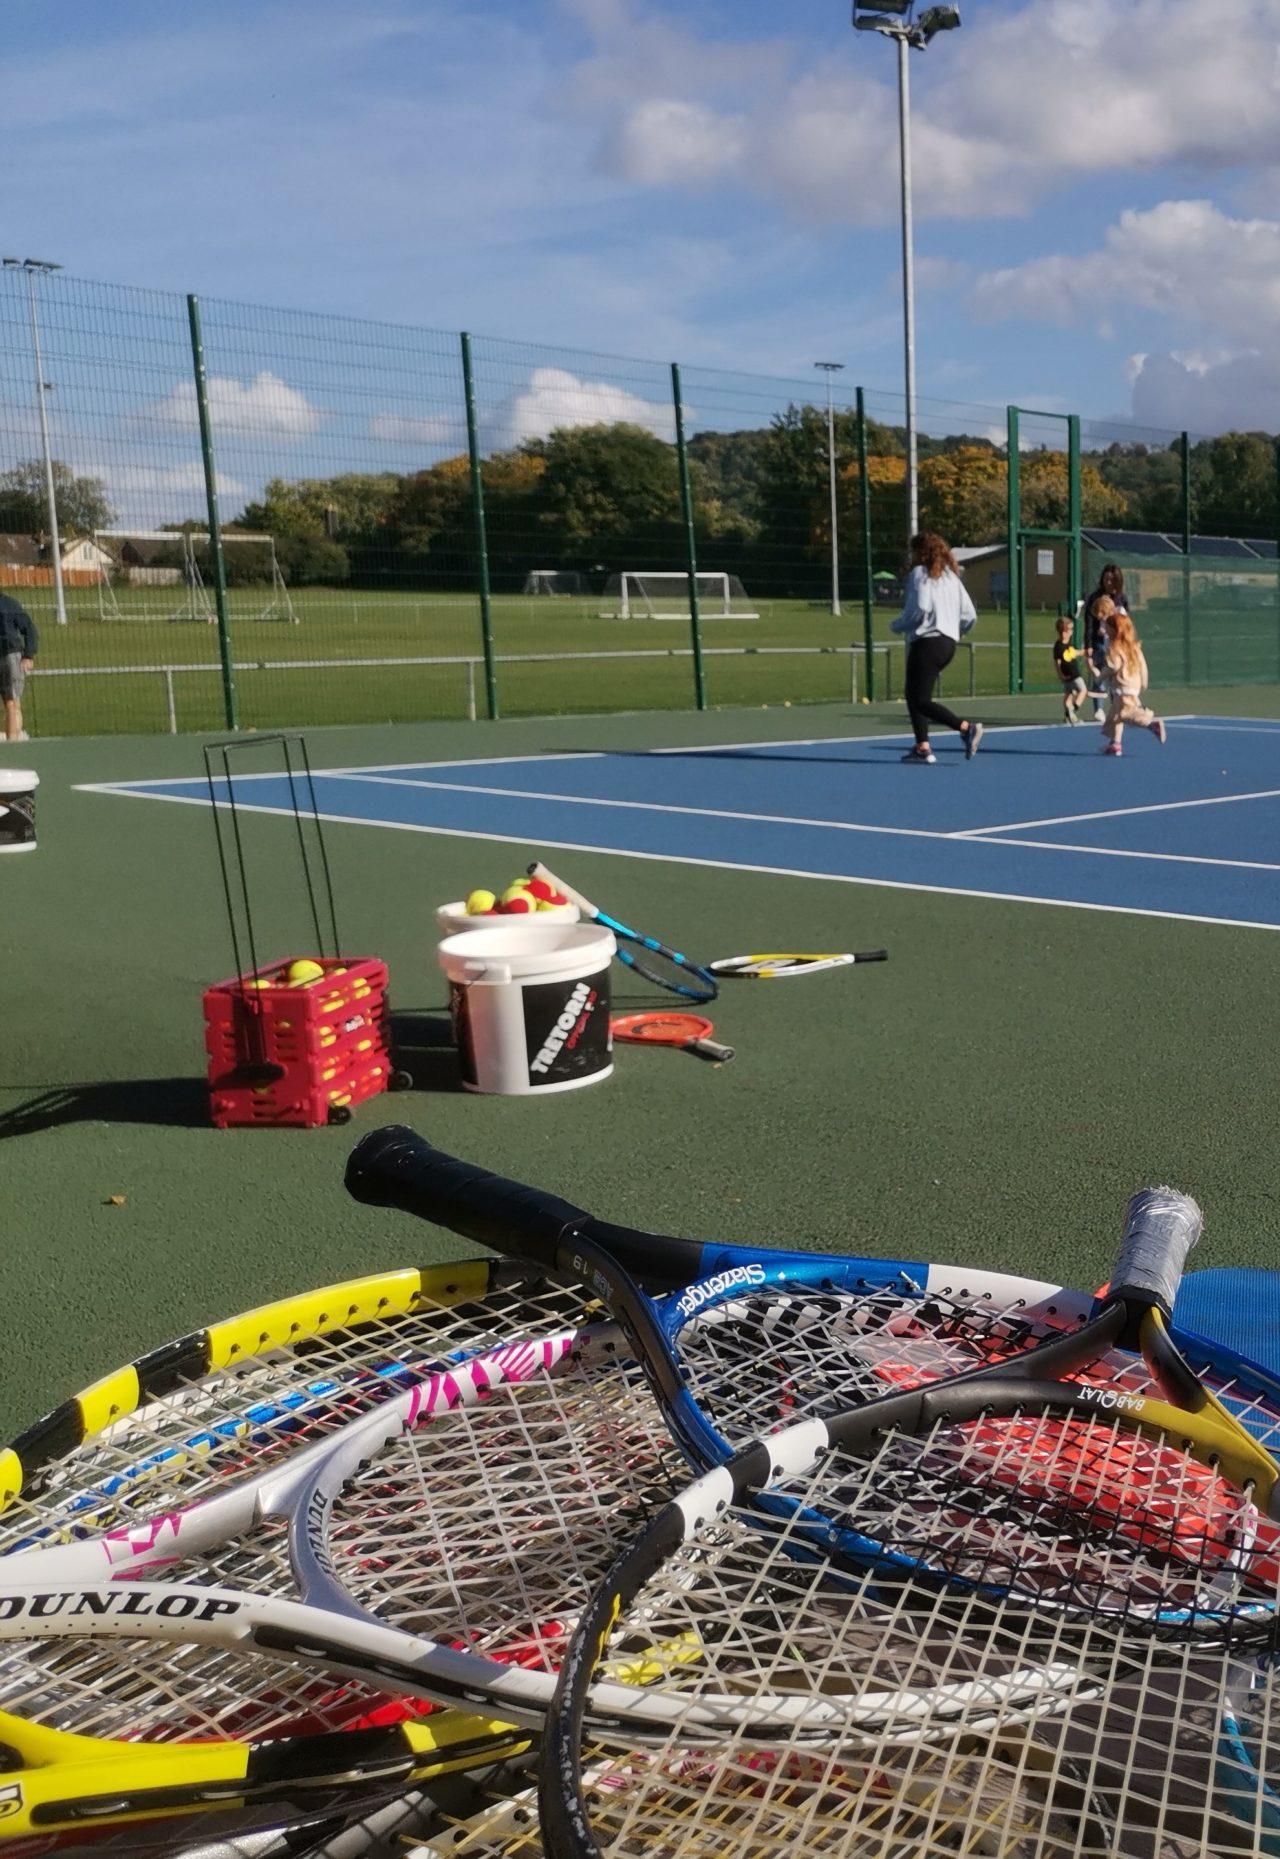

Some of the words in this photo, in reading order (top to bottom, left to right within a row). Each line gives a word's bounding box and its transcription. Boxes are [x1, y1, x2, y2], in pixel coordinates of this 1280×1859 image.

[530, 982, 591, 1073] TRETORN
[681, 1263, 766, 1317] Slazenger
[1077, 1386, 1146, 1412] BABOLAT
[0, 1591, 242, 1622] DUNLOP
